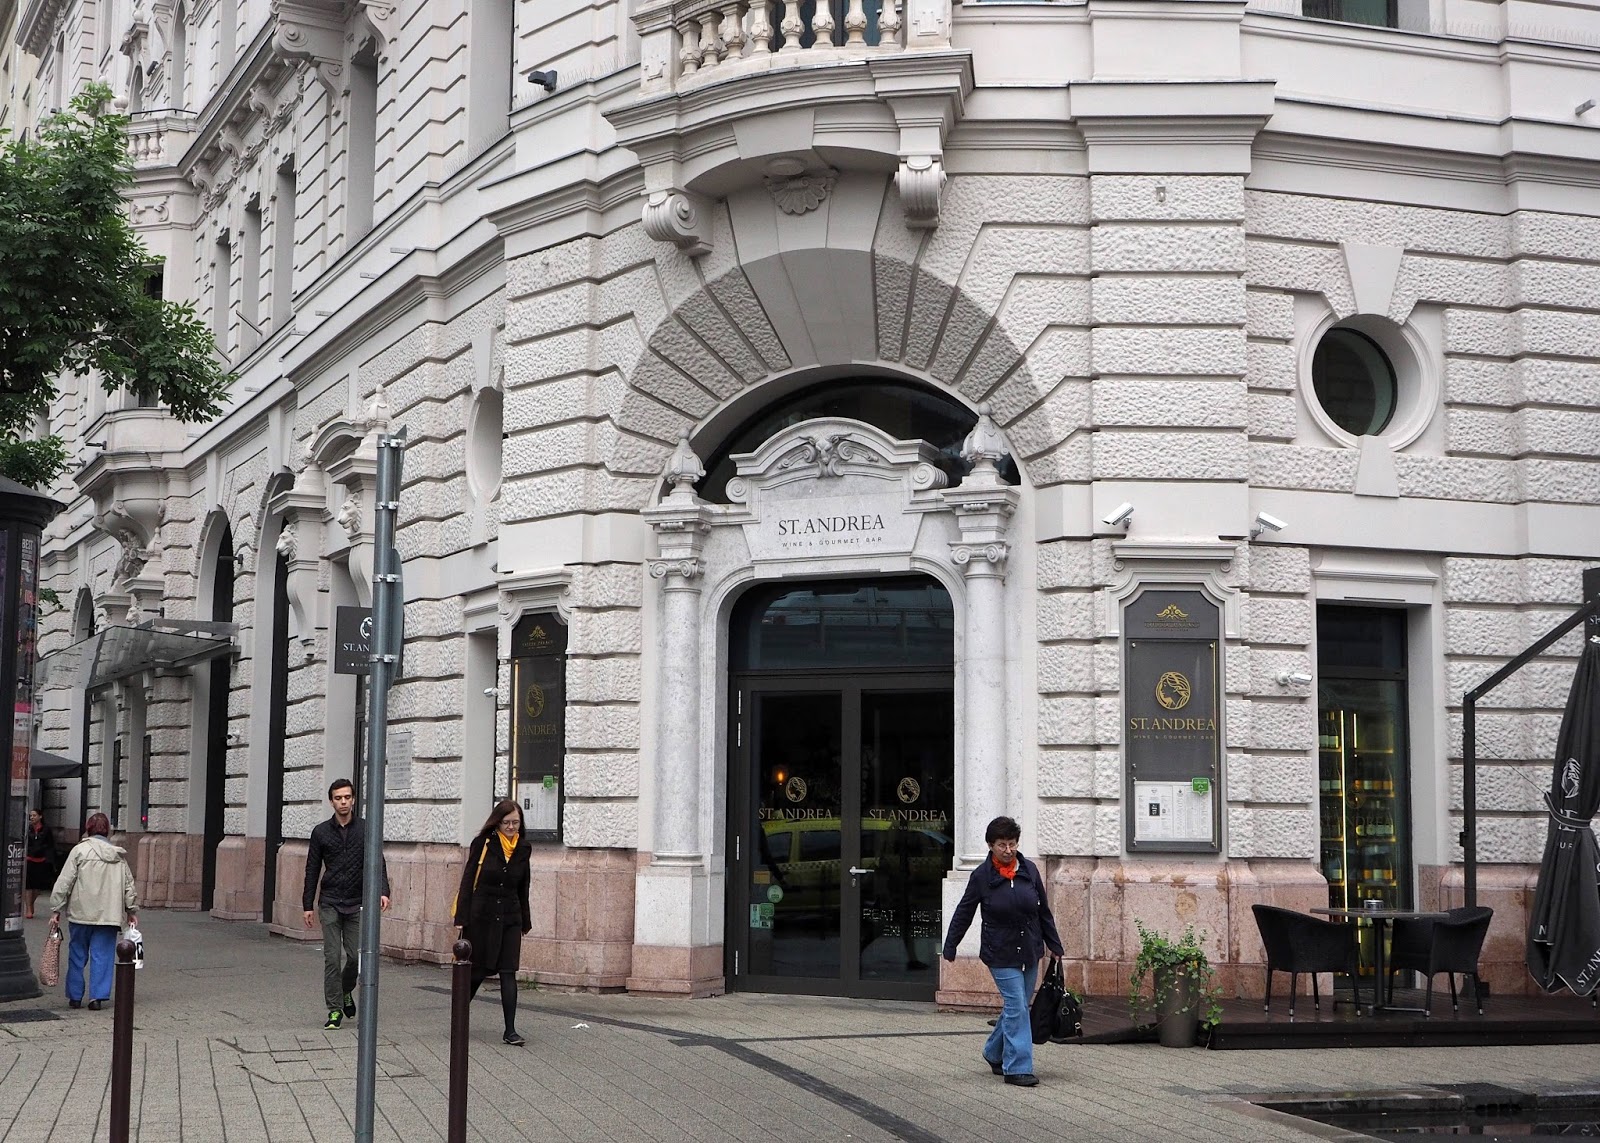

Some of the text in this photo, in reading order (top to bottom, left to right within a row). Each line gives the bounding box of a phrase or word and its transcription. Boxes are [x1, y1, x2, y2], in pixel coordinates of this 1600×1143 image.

[778, 514, 885, 536] ST.ANDREA
[819, 538, 860, 546] GOURMET
[343, 643, 370, 652] ST.AN
[1130, 717, 1216, 731] ST.ANDREA
[758, 807, 833, 820] ST.ANDREA
[869, 808, 947, 822] ST.ANDREA
